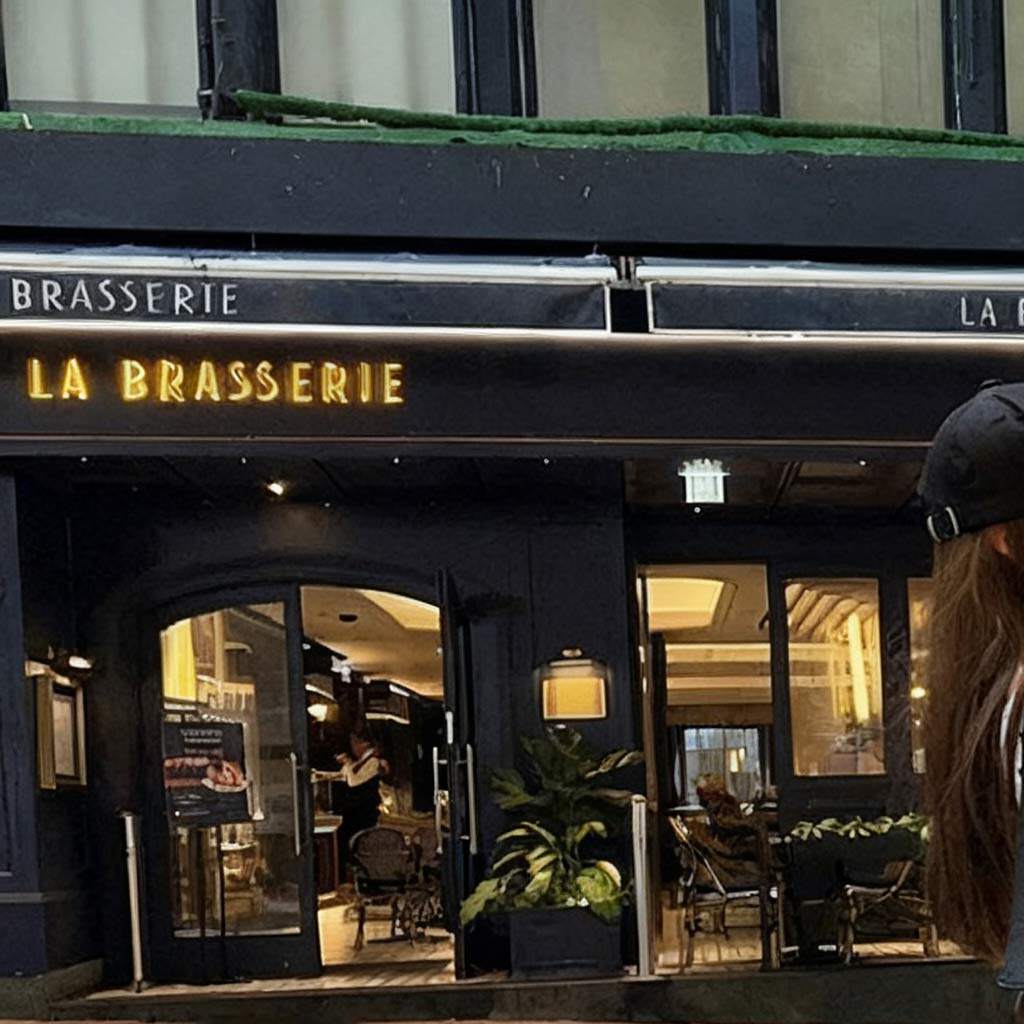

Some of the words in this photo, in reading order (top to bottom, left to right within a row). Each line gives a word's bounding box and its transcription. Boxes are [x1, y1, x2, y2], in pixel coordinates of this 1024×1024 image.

[11, 278, 239, 315] BRASSERIE
[960, 296, 997, 327] LA
[27, 358, 88, 400] LA
[120, 358, 404, 405] BRASSERIE
